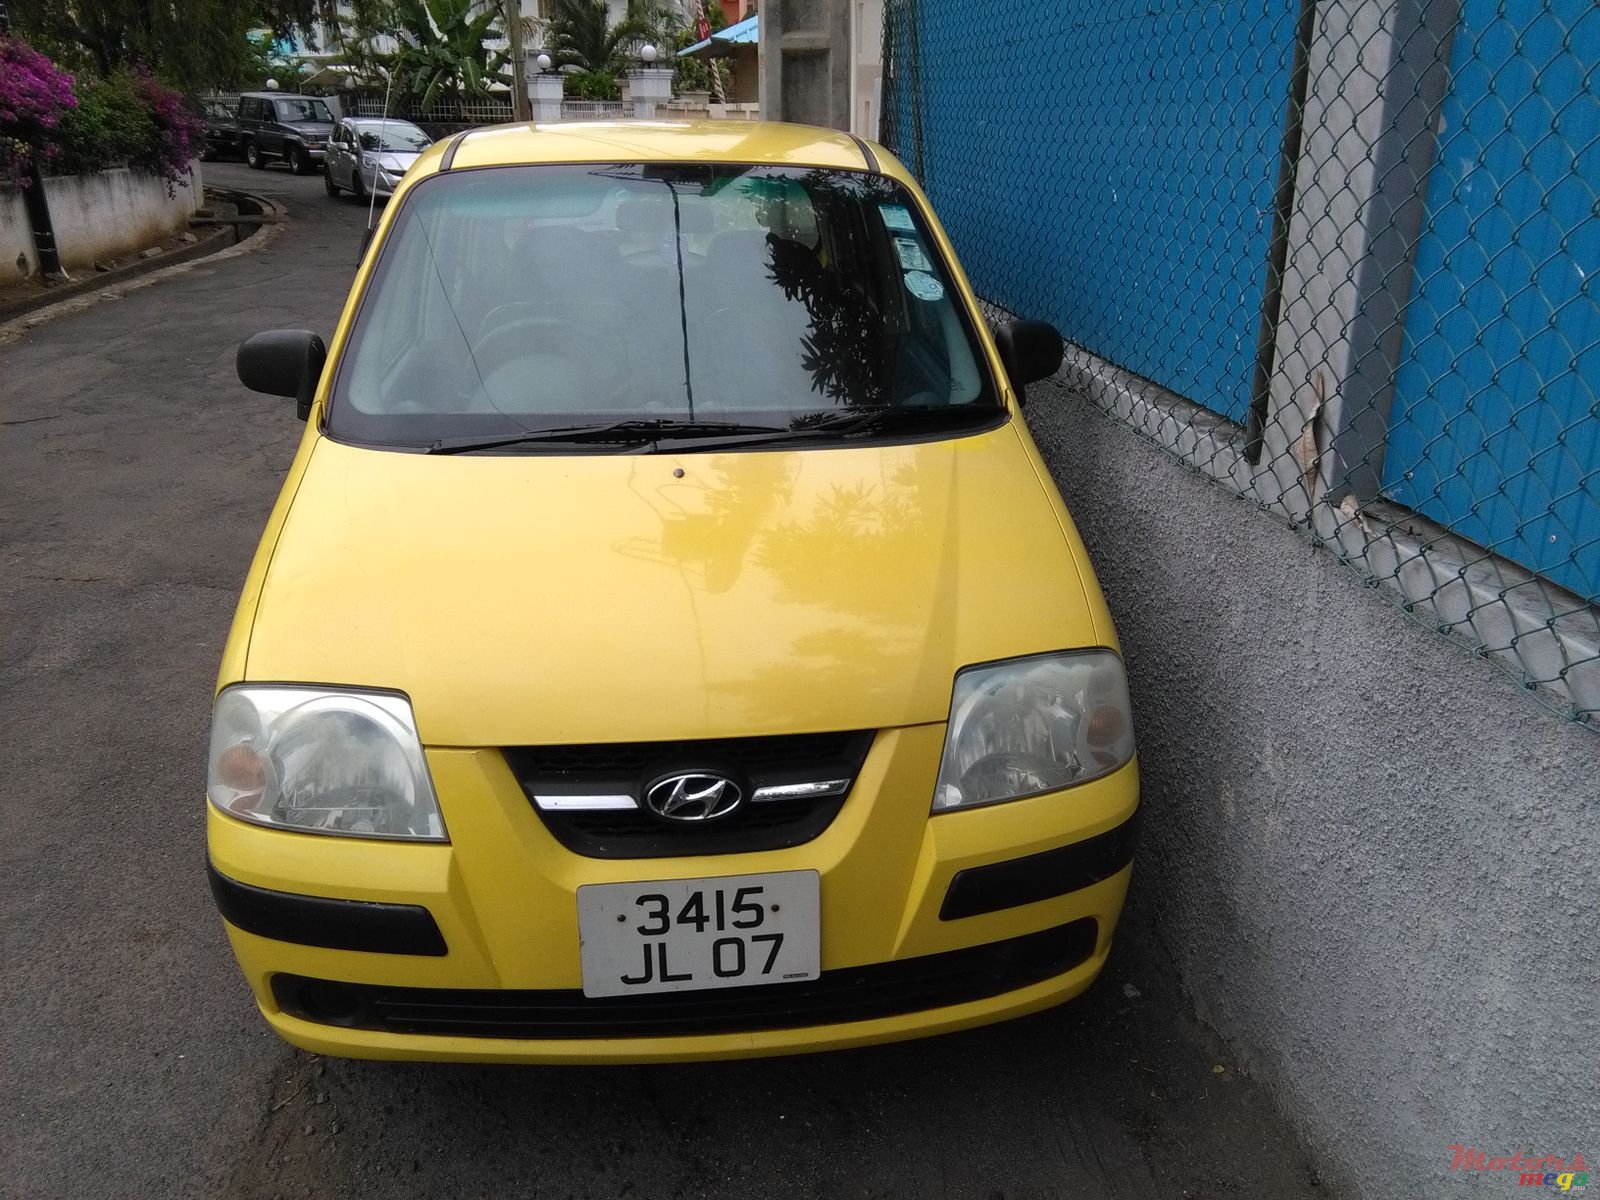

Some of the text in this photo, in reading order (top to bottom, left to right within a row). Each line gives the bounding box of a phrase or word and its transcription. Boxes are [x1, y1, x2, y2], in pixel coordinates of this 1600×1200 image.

[635, 886, 764, 936] 3415
[620, 932, 784, 985] JL 07
